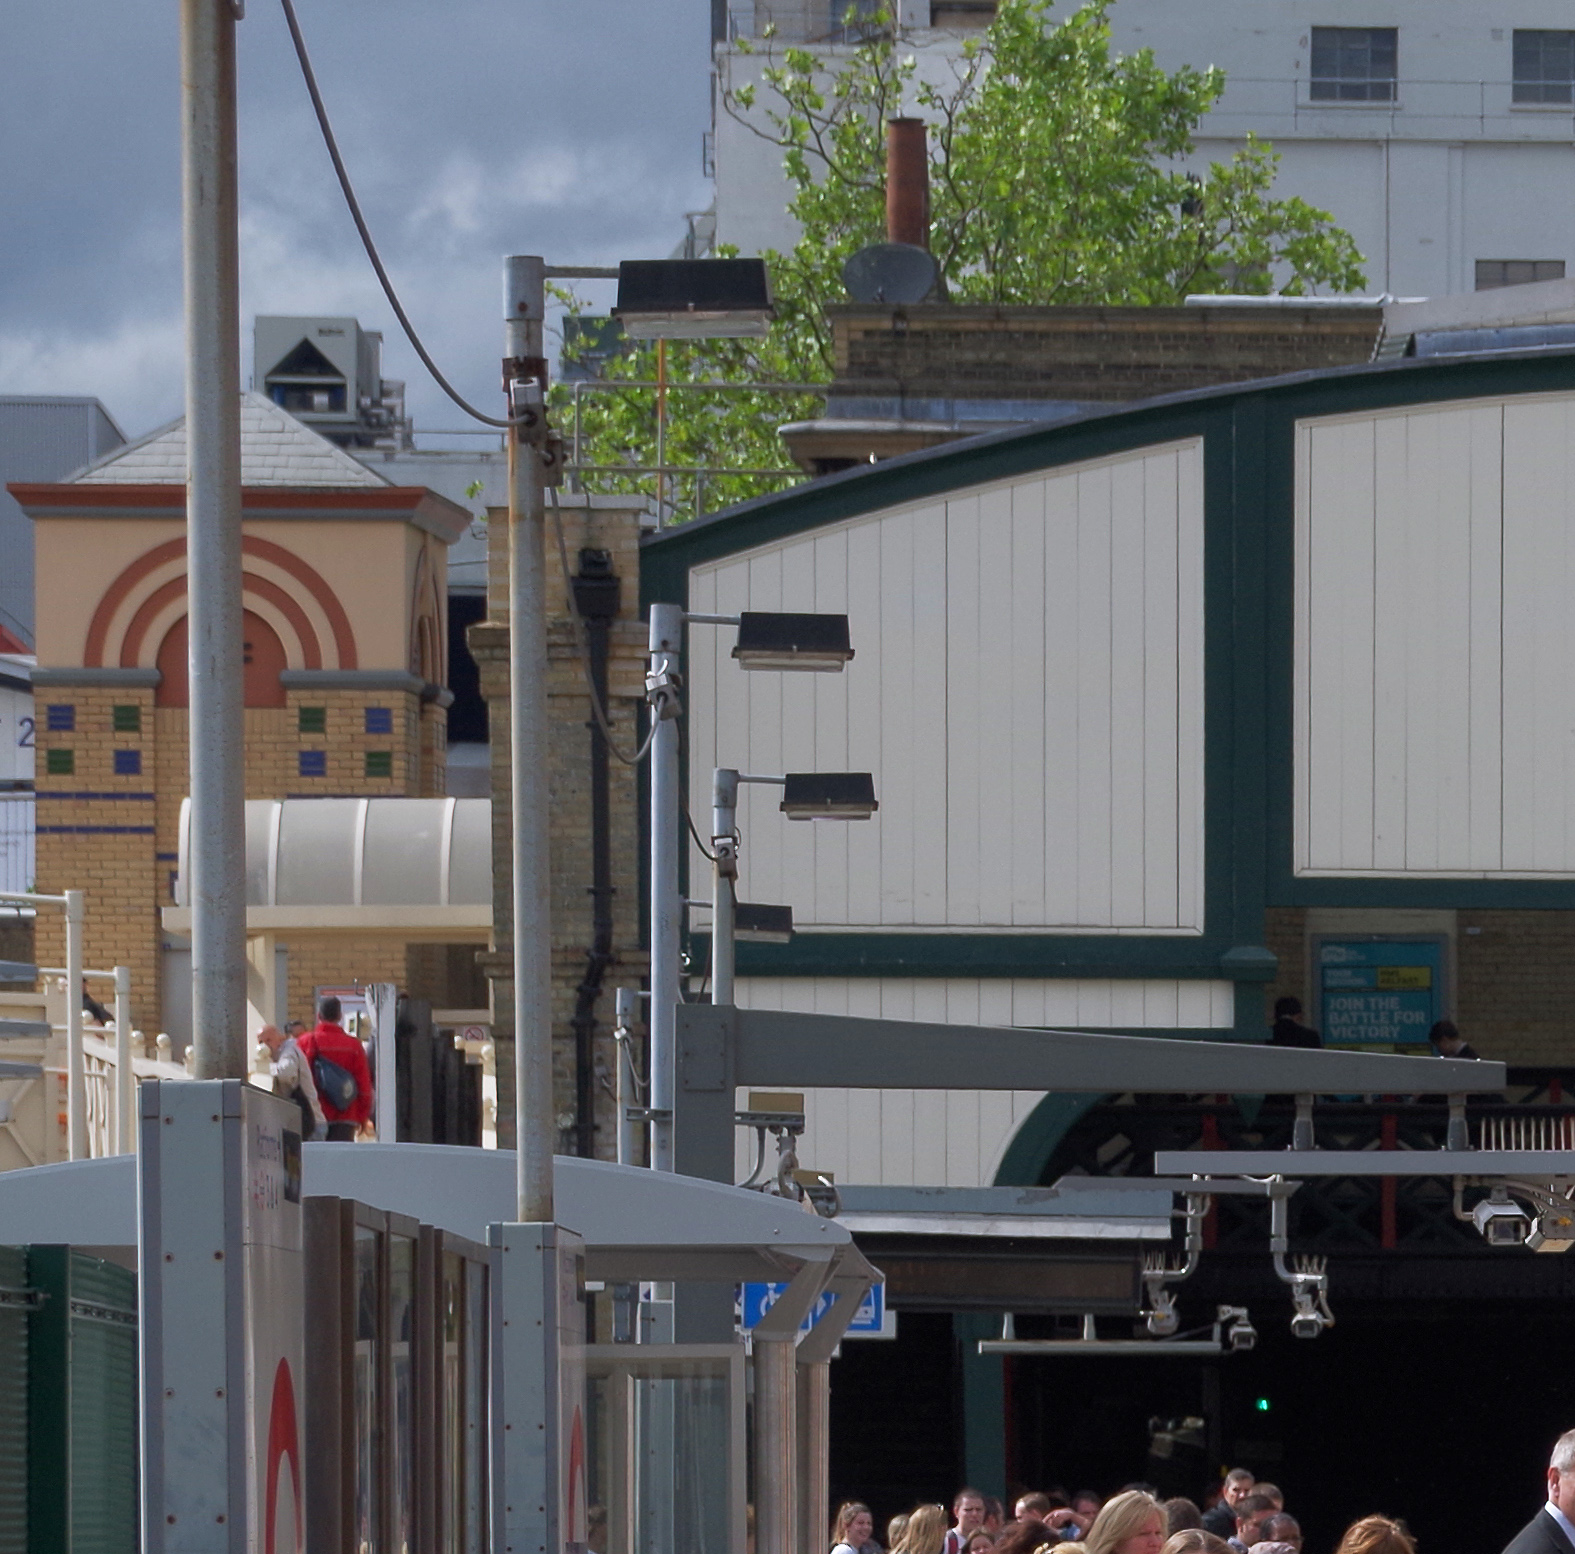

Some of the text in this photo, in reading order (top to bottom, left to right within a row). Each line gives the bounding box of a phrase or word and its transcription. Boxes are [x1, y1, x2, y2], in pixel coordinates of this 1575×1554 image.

[1329, 997, 1400, 1011] JOIN THE
[1328, 1011, 1425, 1025] BATTLE FOR
[1330, 1025, 1401, 1039] VICTORY
